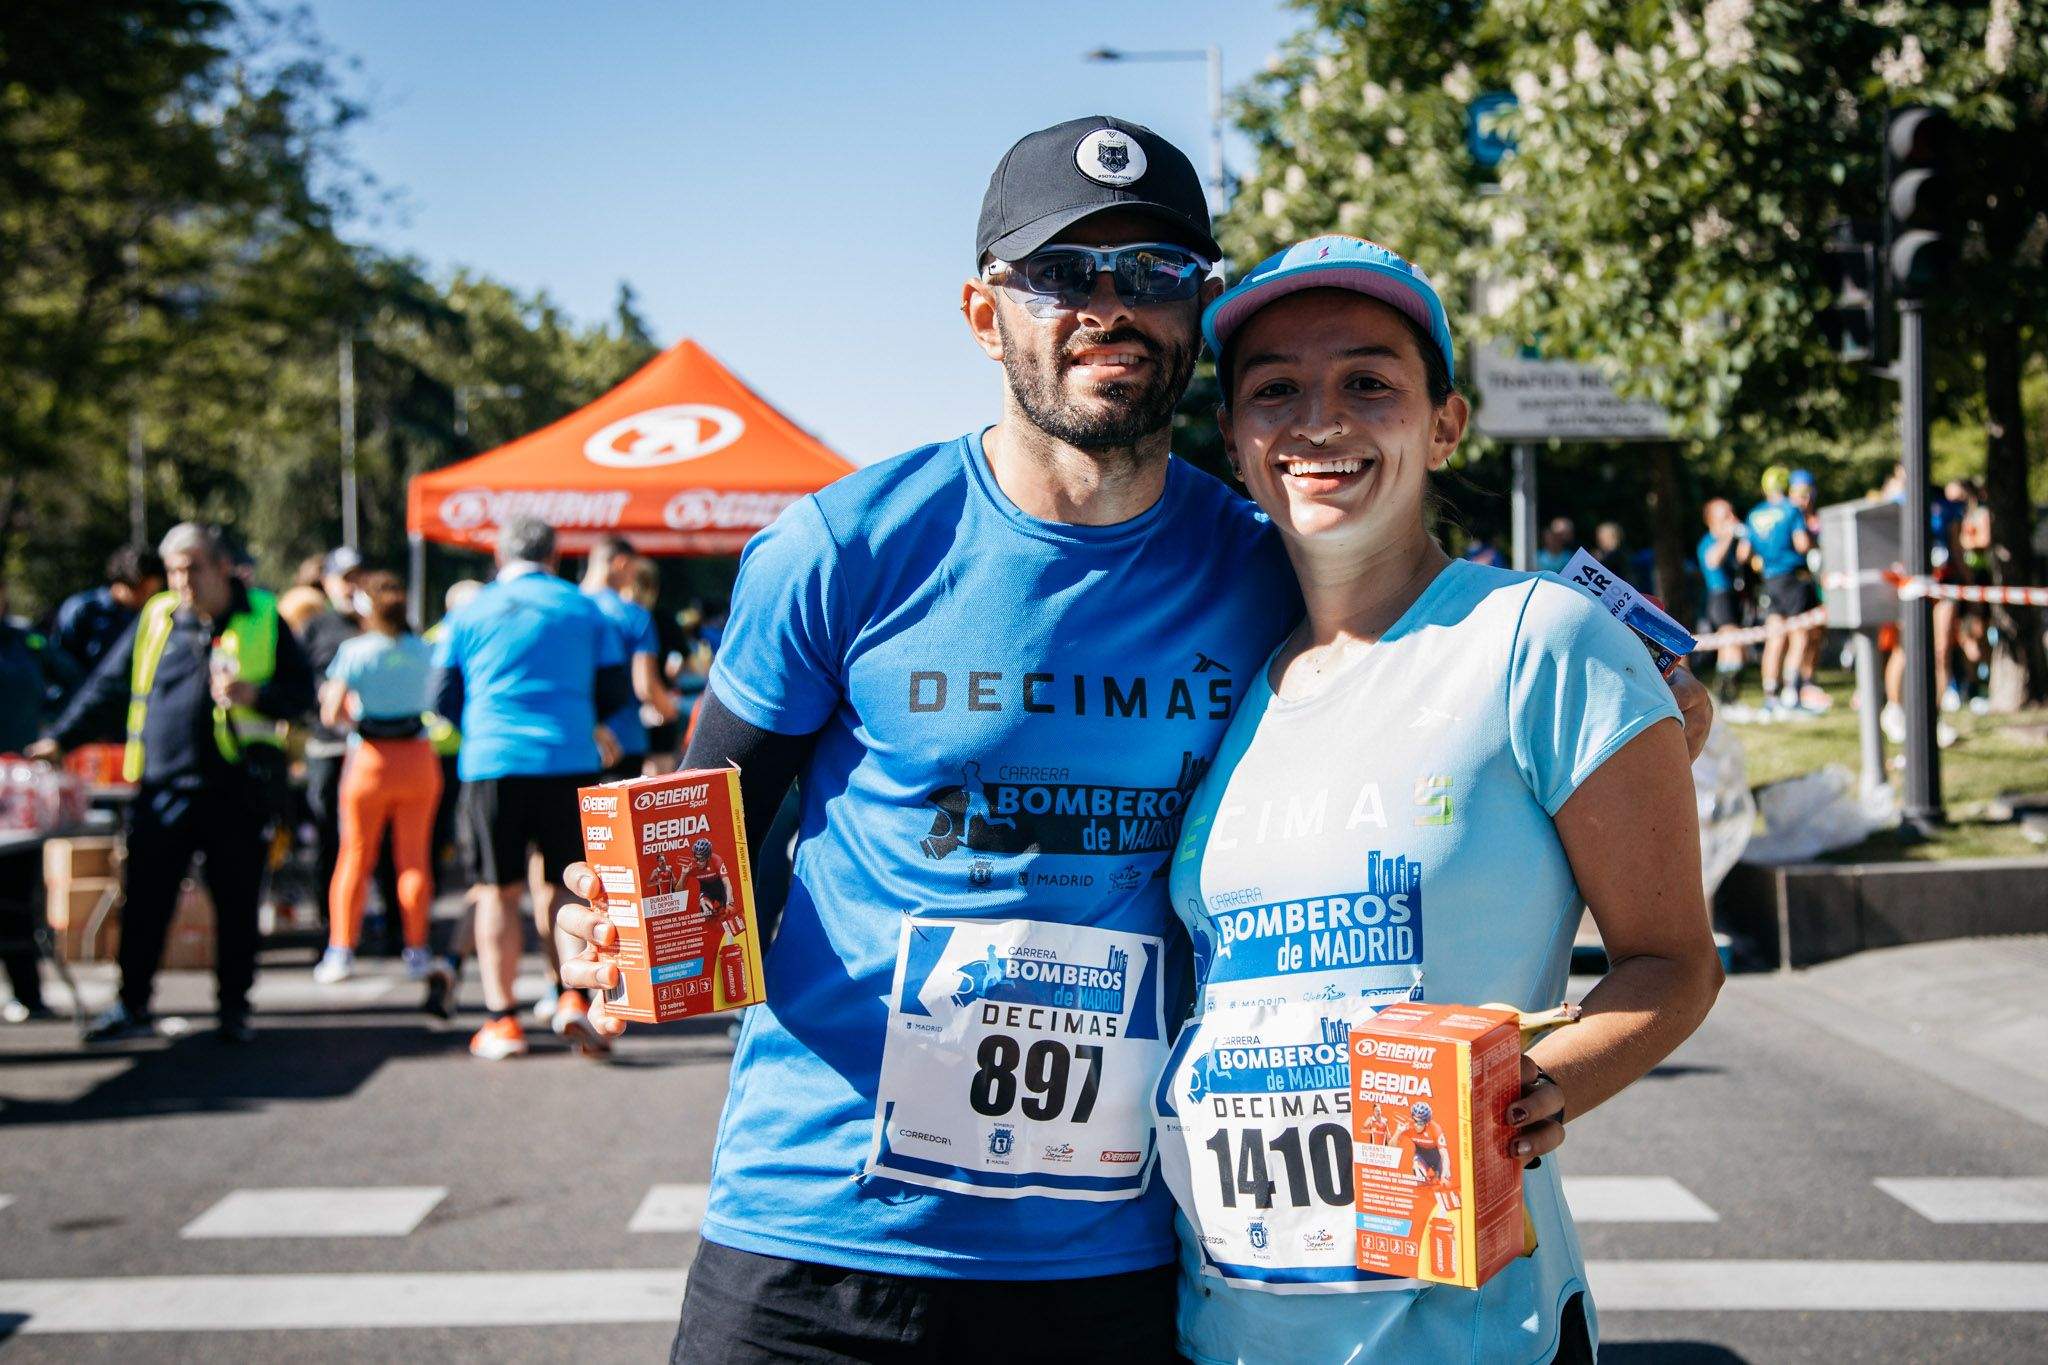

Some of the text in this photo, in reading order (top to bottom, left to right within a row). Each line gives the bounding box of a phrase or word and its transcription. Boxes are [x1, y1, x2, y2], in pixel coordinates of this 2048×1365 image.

[909, 671, 1232, 720] DECIMAS
[1000, 766, 1069, 781] CARRERA
[655, 783, 709, 806] ENERVIT
[689, 799, 708, 808] Sport
[998, 787, 1190, 817] BOMBERO
[643, 813, 710, 842] BEBIDA
[1083, 819, 1111, 850] de
[642, 838, 690, 855] ISOTÓNICA
[1037, 874, 1094, 887] MADRID
[650, 895, 673, 904] DURANTE
[658, 900, 680, 909] DEPORTE
[1209, 886, 1263, 910] CARRERA
[1217, 894, 1412, 945] BOMBEROS
[1007, 946, 1057, 960] CARRERA
[1277, 926, 1413, 972] de MADRID
[1005, 959, 1122, 991] BOMBEROS
[667, 1001, 685, 1009] sobres
[1054, 986, 1122, 1013] de MADRID
[915, 1023, 943, 1032] MADRID
[982, 1004, 1117, 1037] DECIMAS
[1219, 1043, 1349, 1070] BOMBEROS
[1376, 1040, 1437, 1062] ENERVIT
[1267, 1064, 1350, 1091] de MADRID
[1412, 1061, 1433, 1070] Sport
[969, 1035, 1104, 1123] 897
[1361, 1070, 1433, 1098] BEBIDA
[1213, 1092, 1350, 1118] DECIMAS
[1206, 1122, 1355, 1209] 1410
